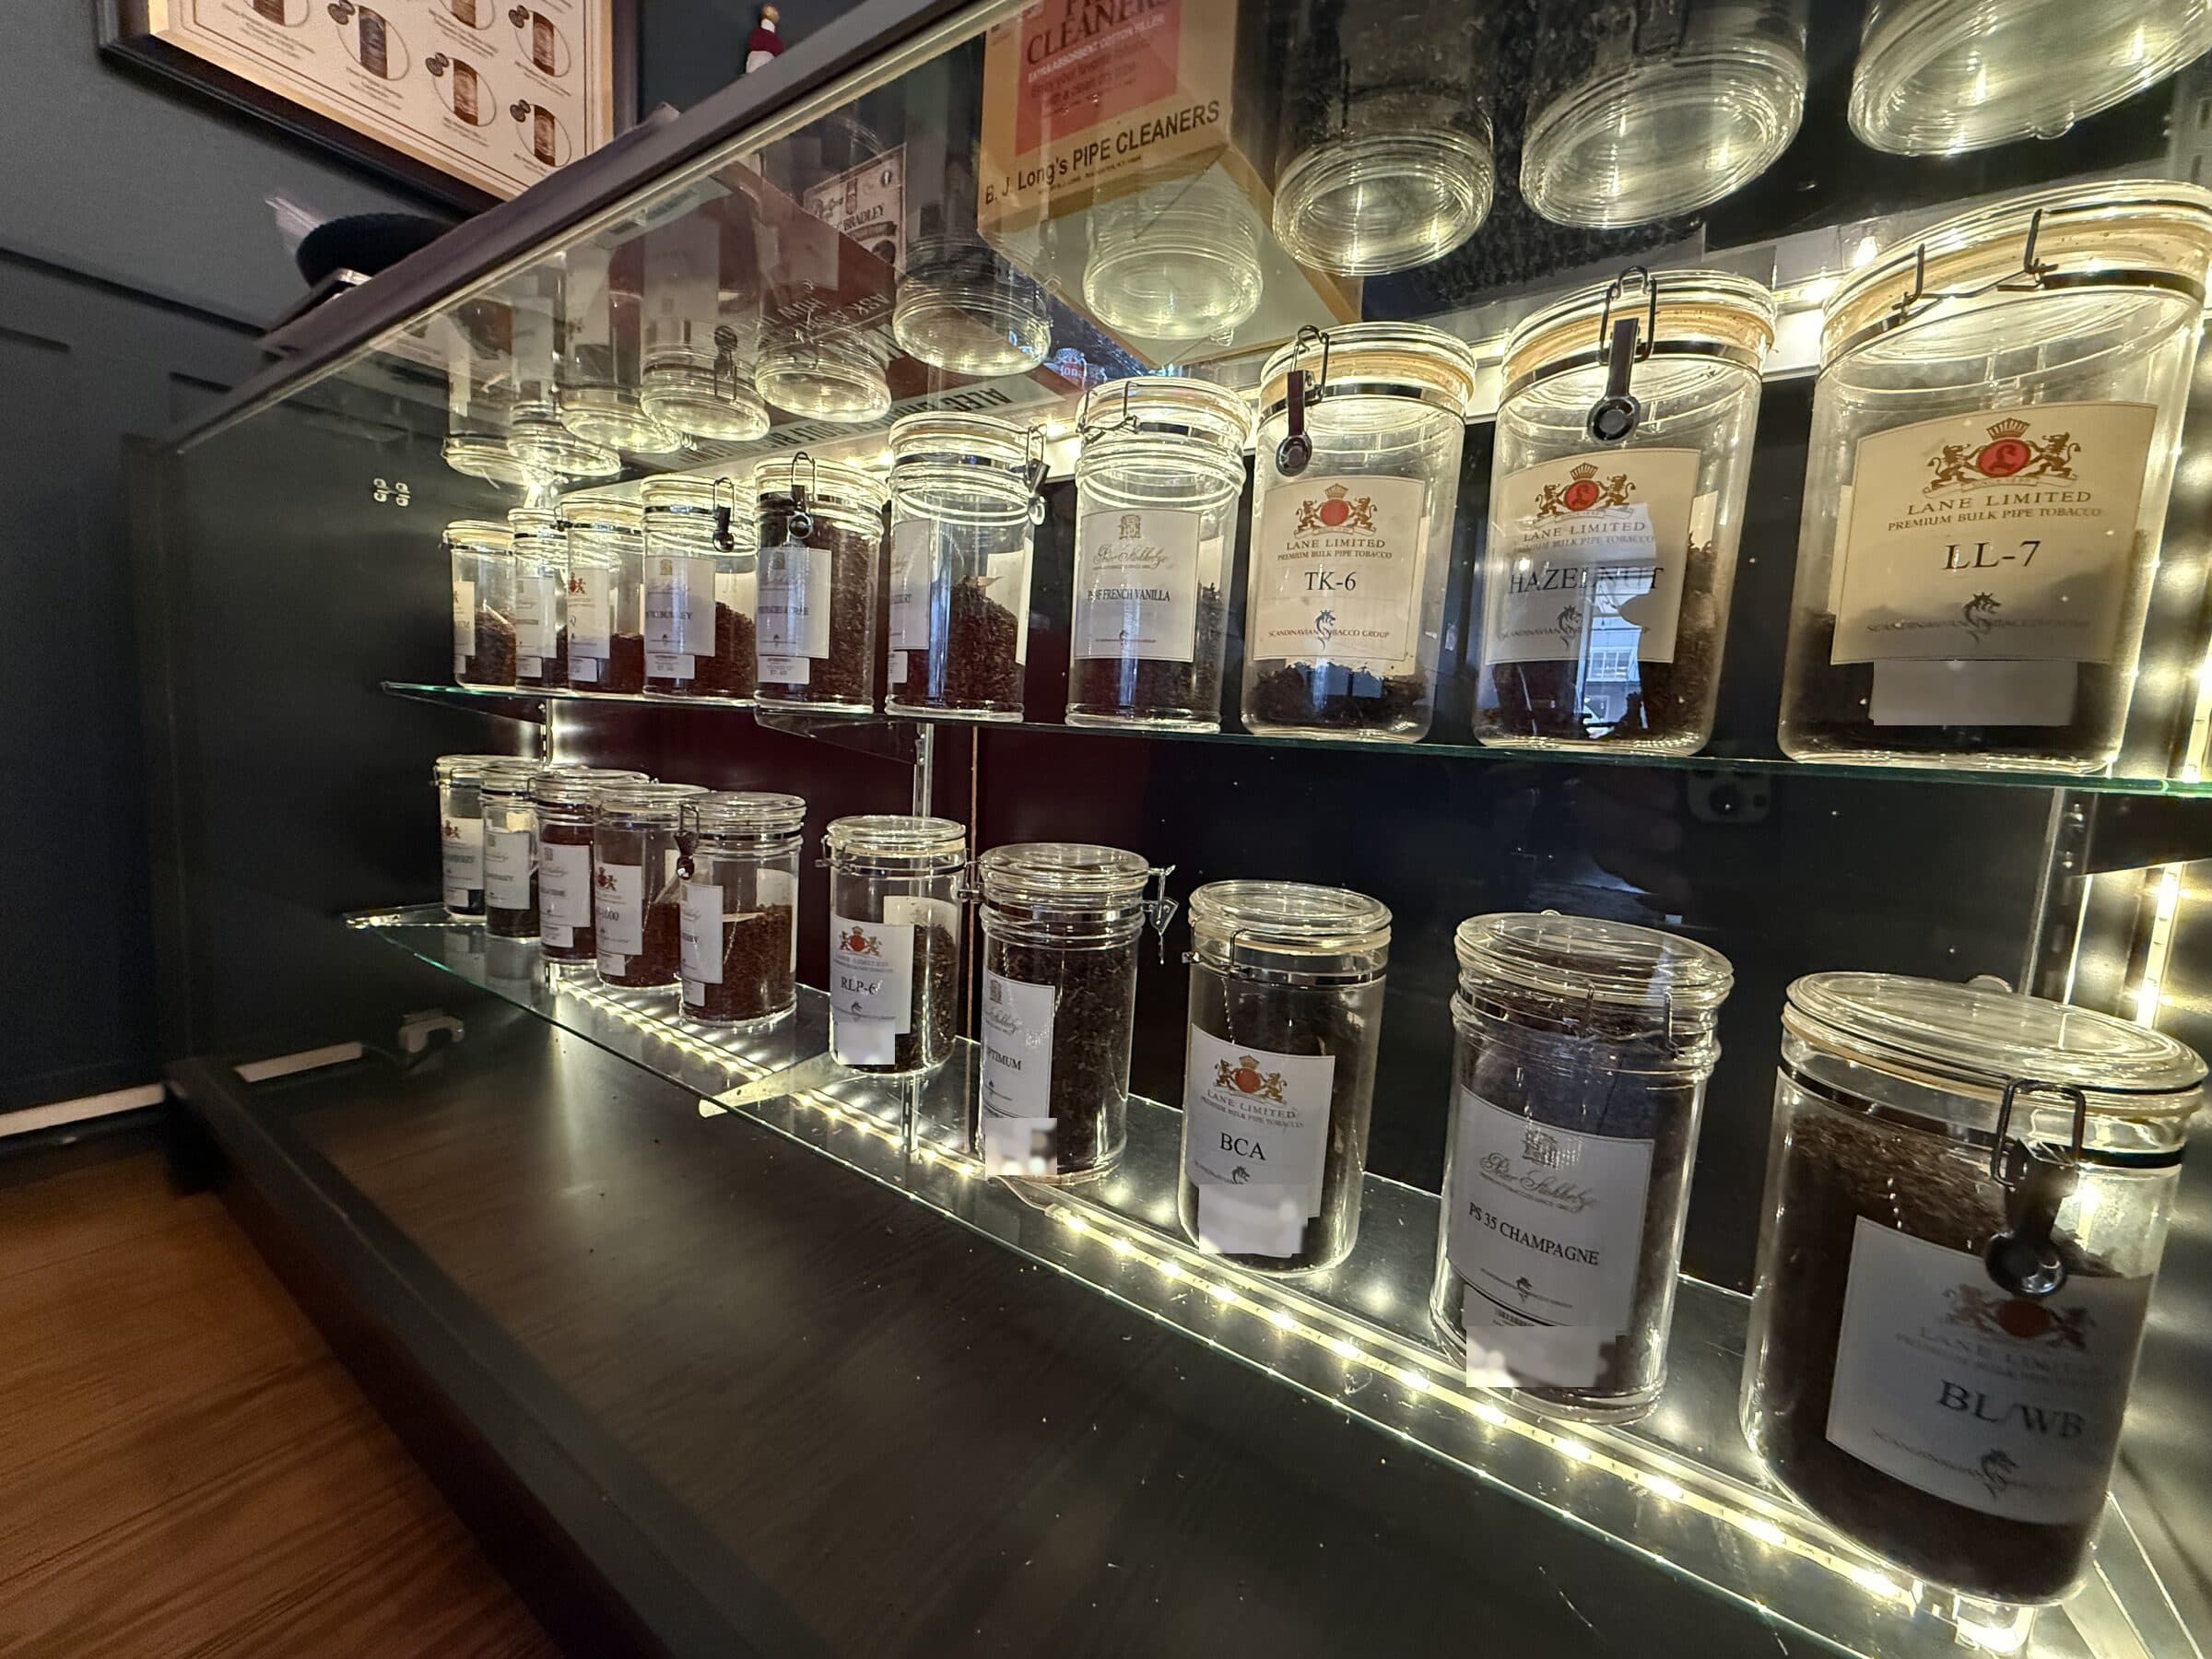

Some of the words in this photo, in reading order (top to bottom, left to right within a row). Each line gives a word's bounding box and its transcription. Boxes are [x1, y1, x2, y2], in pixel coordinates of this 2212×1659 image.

[985, 184, 998, 205] B.
[1018, 156, 1068, 191] Long's
[1073, 137, 1112, 171] PIPE
[1115, 100, 1221, 155] CLEANERS
[1907, 498, 1973, 516] LANE
[1985, 490, 2092, 507] LIMITED
[1888, 514, 1952, 532] PREMIUM
[1958, 510, 1998, 524] BULK
[2002, 507, 2034, 519] PIPE
[2039, 506, 2104, 518] TOBACCO
[1524, 526, 1563, 542] LANE
[1571, 521, 1646, 535] LIMITED
[1580, 536, 1601, 547] PIPE
[1605, 535, 1655, 545] TOBACCO
[1277, 550, 1310, 560] PREMIUM
[1335, 549, 1352, 558] PIPE
[1355, 550, 1393, 559] TOBACCO
[1287, 539, 1320, 550] LANE
[1325, 538, 1385, 548] LIMITED
[1941, 539, 2042, 571] LL-7
[1304, 571, 1357, 592] TK-6
[1103, 588, 1134, 600] FRENCH
[1135, 588, 1171, 602] VANILLA
[1267, 628, 1319, 638] SCANDINAVIAN
[1362, 629, 1390, 639] GROUP
[841, 976, 877, 995] RLP-6
[1207, 1088, 1235, 1107] LANE
[1240, 1102, 1296, 1119] LIMITED
[1220, 1132, 1266, 1161] BCA
[1469, 1201, 1483, 1222] PS
[1483, 1212, 1498, 1230] 35
[1500, 1220, 1600, 1266] CHAMPAGNE
